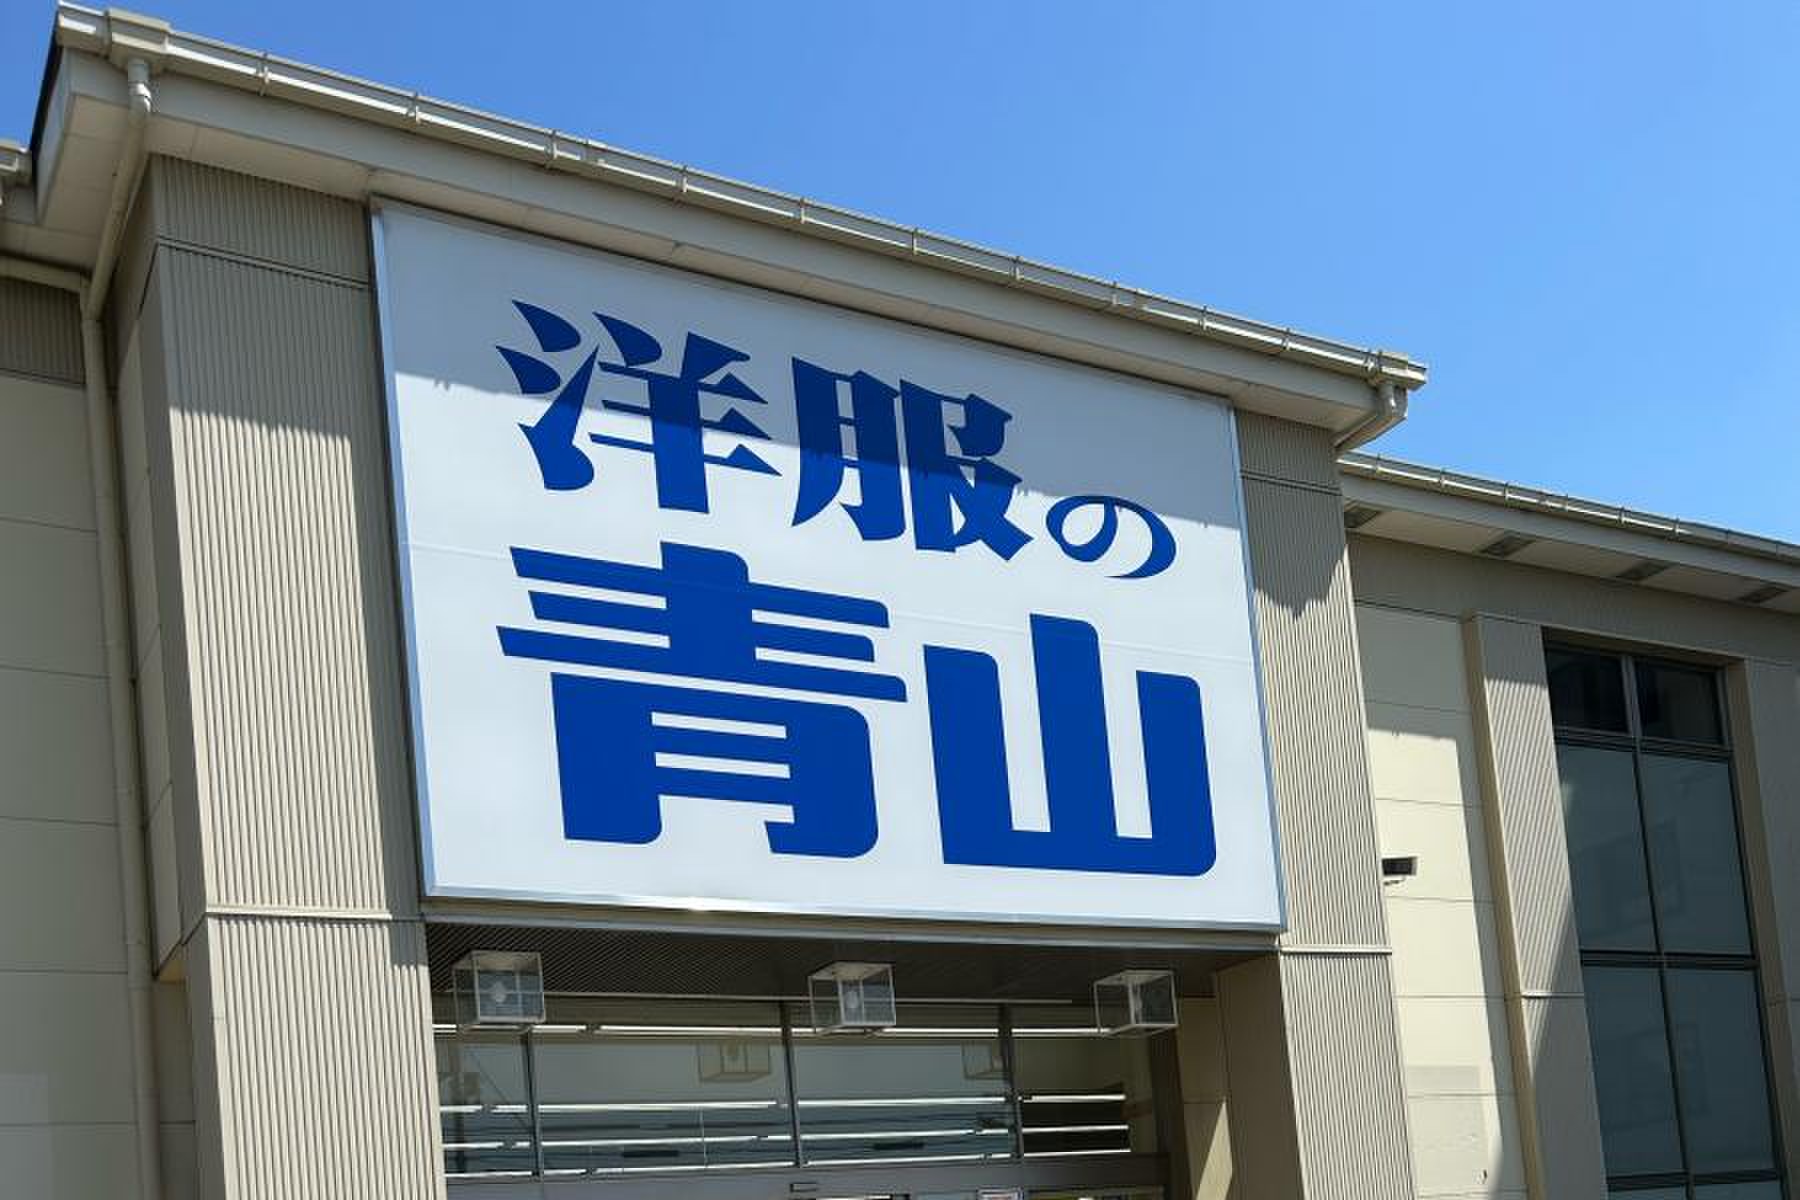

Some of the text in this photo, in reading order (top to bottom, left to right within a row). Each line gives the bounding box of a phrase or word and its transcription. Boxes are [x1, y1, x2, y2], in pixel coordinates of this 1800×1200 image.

[496, 300, 1177, 579] 洋服の
[496, 541, 1217, 877] 青山
